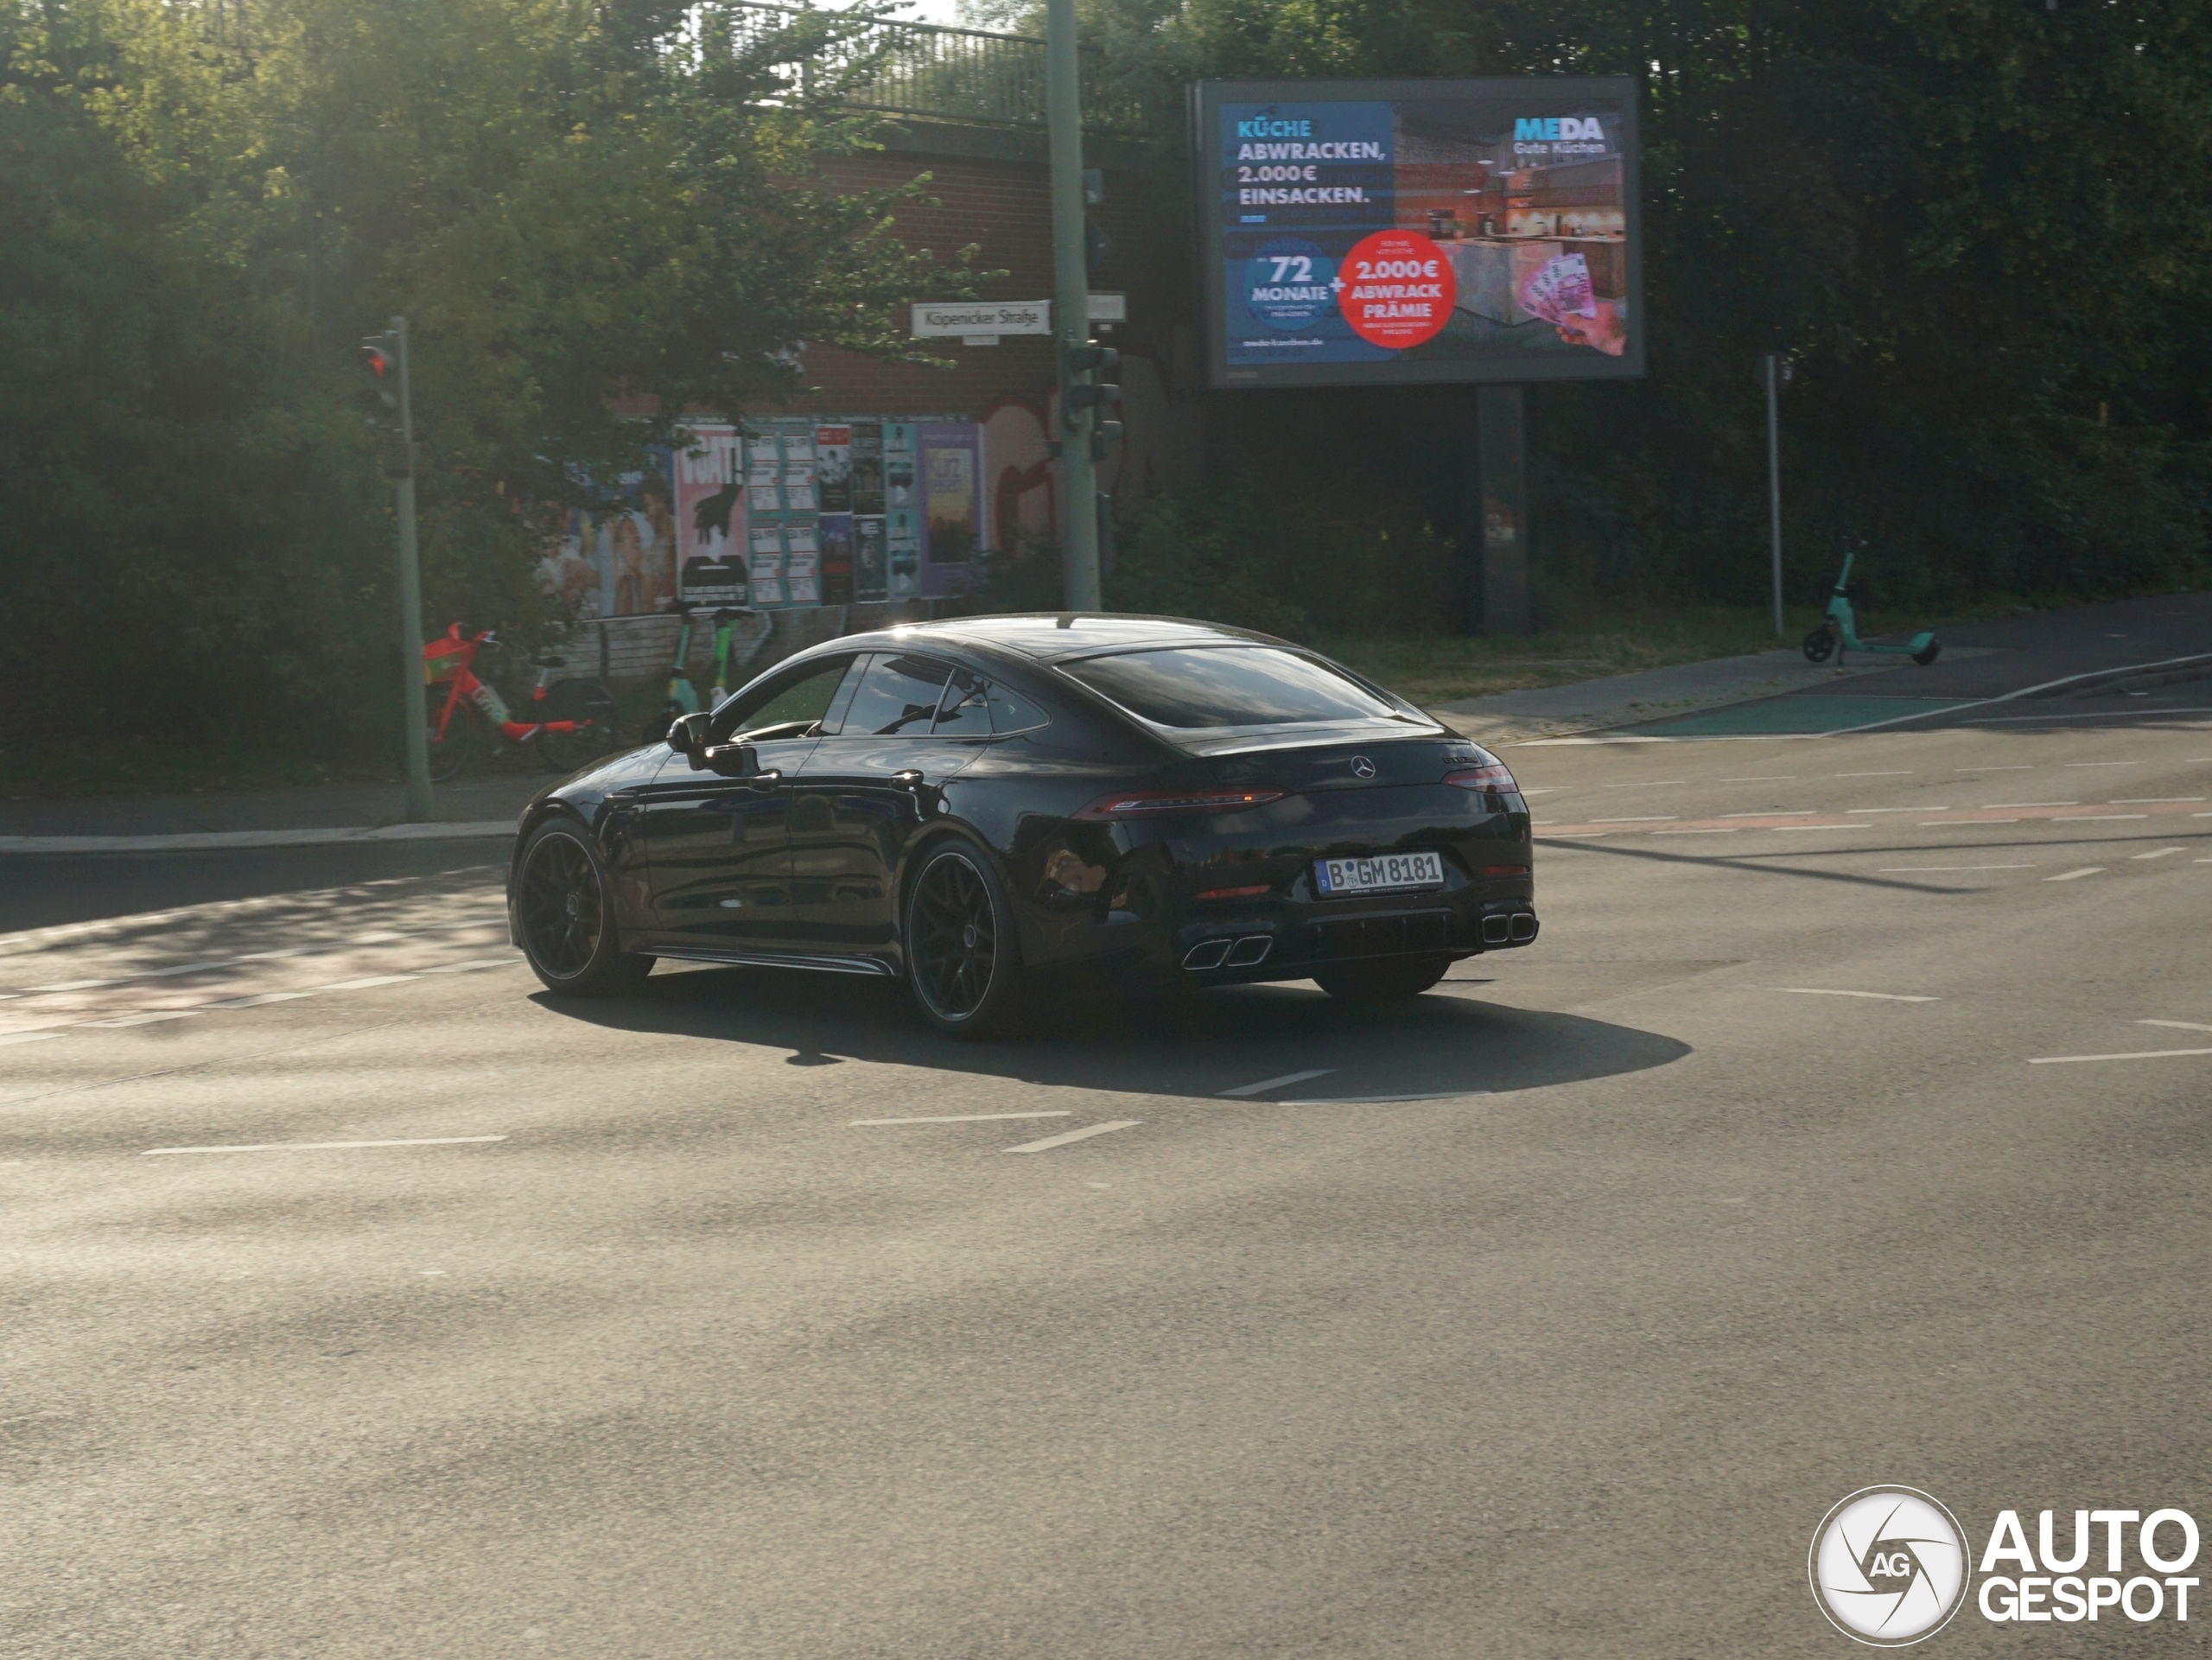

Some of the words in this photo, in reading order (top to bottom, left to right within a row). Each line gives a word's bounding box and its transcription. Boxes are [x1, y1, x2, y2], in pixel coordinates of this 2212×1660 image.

[1237, 116, 1312, 137] KÜCHE
[1513, 118, 1606, 141] MEDA
[1237, 142, 1387, 161] ABWRACKEN,
[1513, 142, 1548, 155] Gute
[1552, 141, 1606, 154] Küchen
[1239, 187, 1371, 205] EINSACKEN.
[1268, 256, 1313, 283] 72
[1251, 285, 1328, 302] MONATE
[1351, 283, 1443, 300] ABWRACK
[924, 310, 994, 328] Köpenicker
[997, 308, 1039, 328] Straße
[1363, 301, 1433, 319] PRÄMIE
[1321, 879, 1327, 887] D
[1329, 862, 1344, 888] B
[1357, 860, 1387, 885] GM
[1388, 855, 1440, 883] 8181
